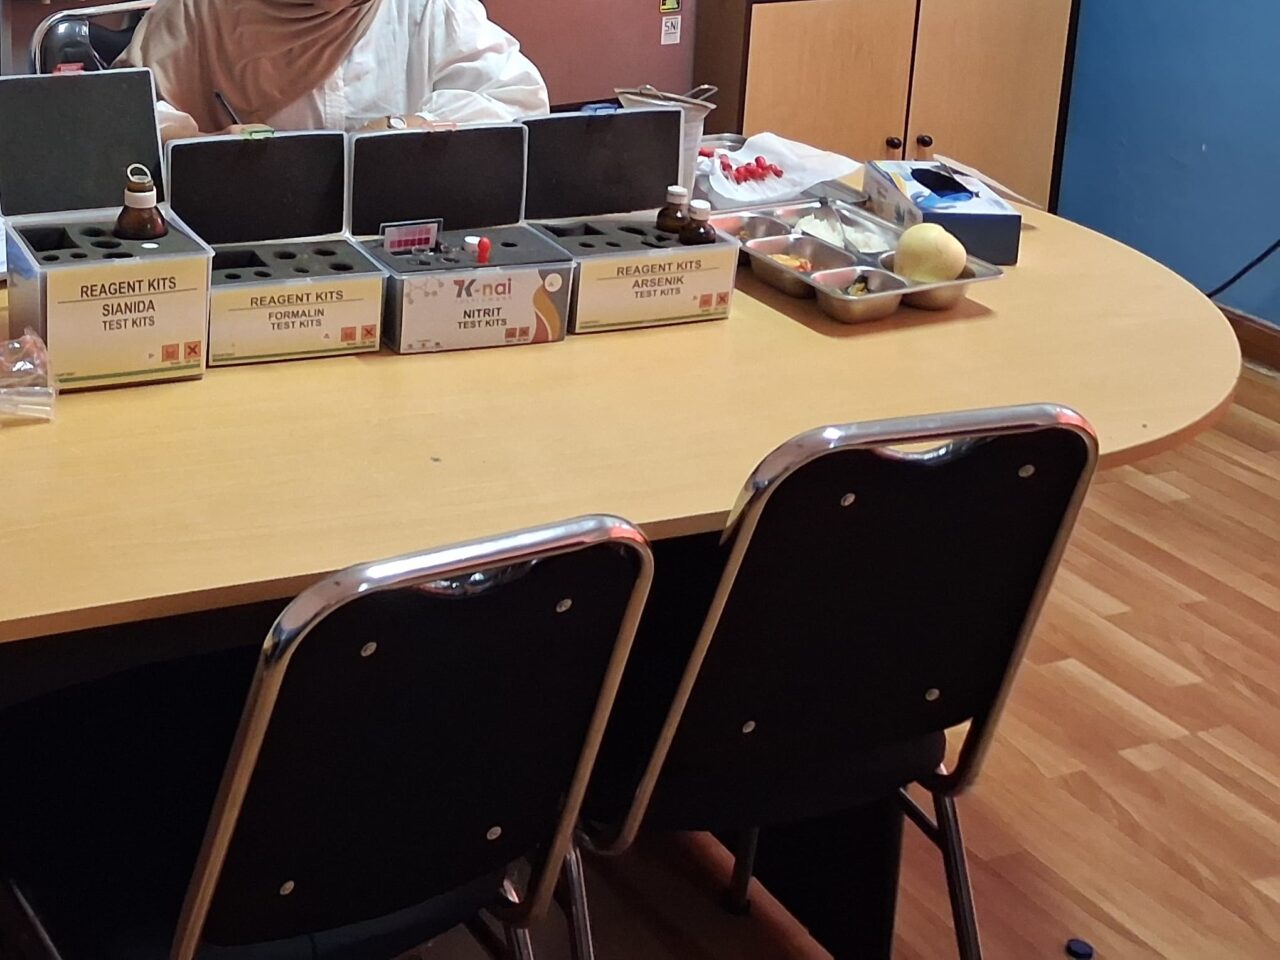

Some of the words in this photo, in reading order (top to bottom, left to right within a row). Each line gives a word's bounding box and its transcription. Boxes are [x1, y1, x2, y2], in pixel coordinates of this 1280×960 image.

[664, 20, 679, 32] SNI
[616, 262, 674, 276] REAGENT
[676, 259, 702, 271] KITS
[80, 279, 144, 298] REAGENT
[147, 276, 177, 291] KITS
[631, 275, 685, 289] ARSENIK
[250, 292, 312, 306] REAGENT
[315, 290, 344, 302] KITS
[634, 289, 658, 299] TEST
[660, 287, 681, 297] KITS
[102, 299, 156, 317] SIANIDA
[268, 308, 325, 321] FORMALIN
[463, 307, 503, 319] NITRIT
[102, 318, 129, 331] TEST
[131, 315, 156, 328] KITS
[271, 321, 296, 331] TEST
[299, 319, 322, 328] KITS
[457, 320, 483, 330] TEST
[484, 318, 508, 327] KITS
